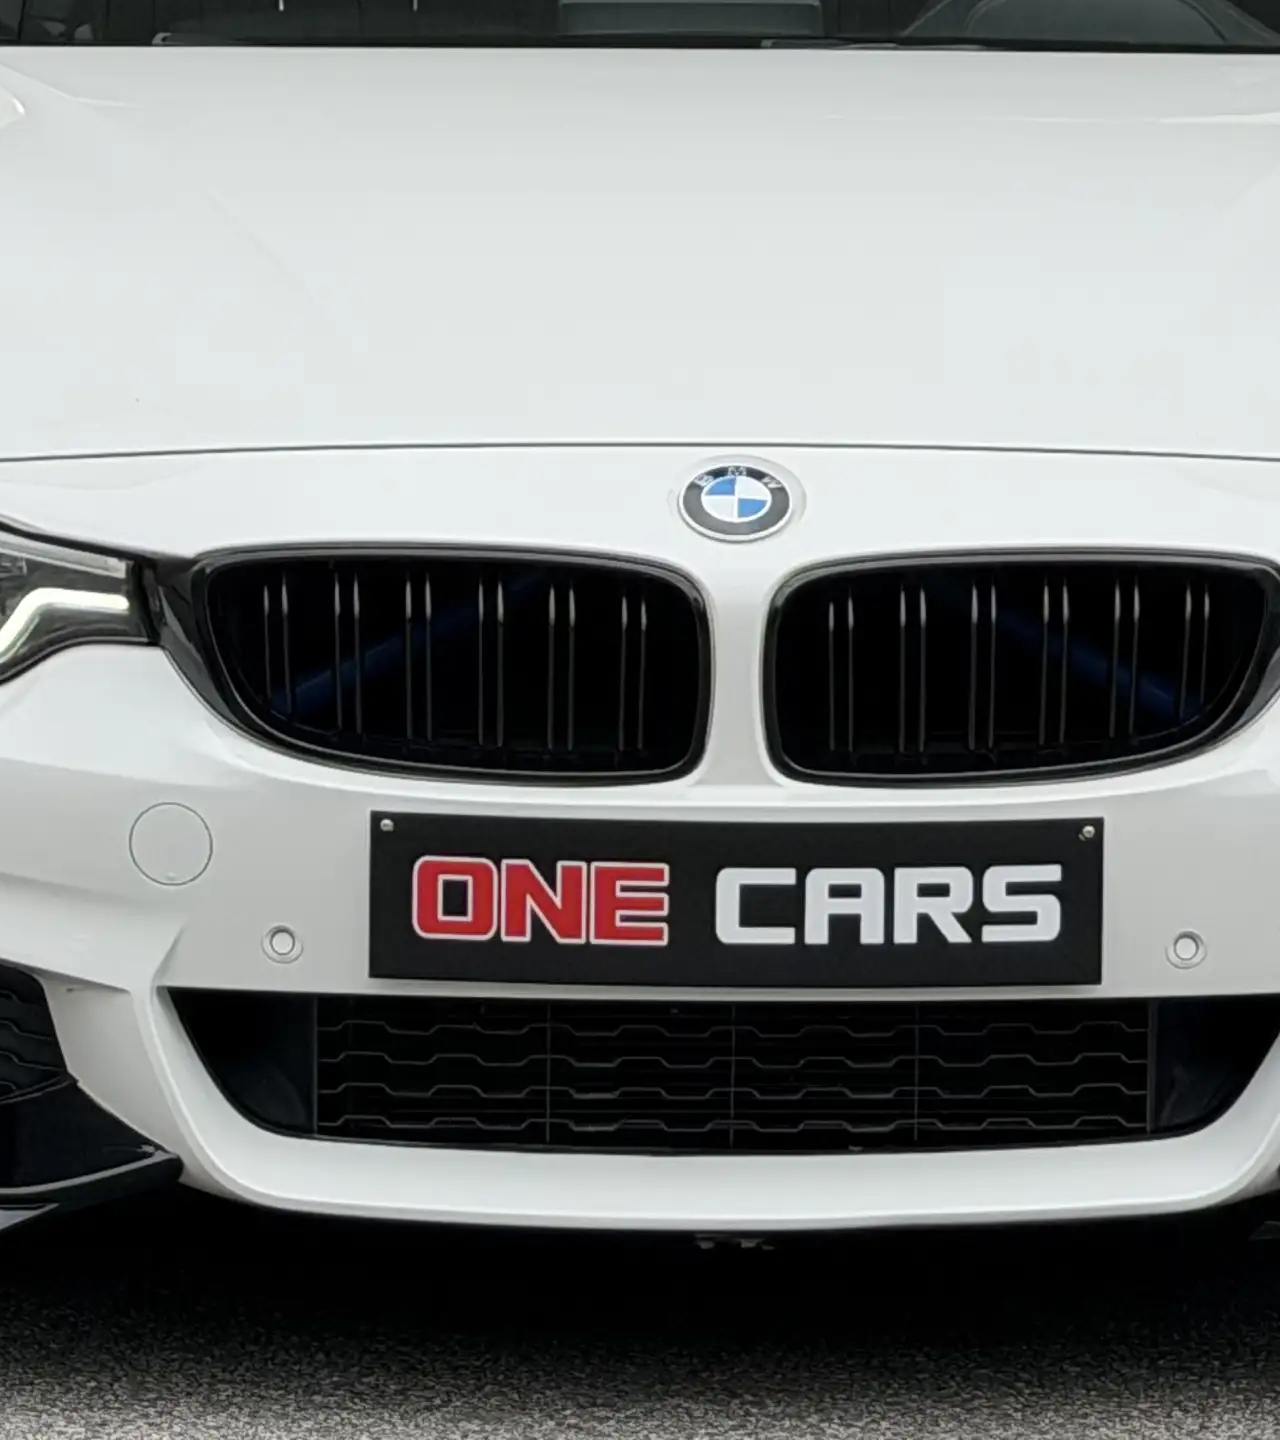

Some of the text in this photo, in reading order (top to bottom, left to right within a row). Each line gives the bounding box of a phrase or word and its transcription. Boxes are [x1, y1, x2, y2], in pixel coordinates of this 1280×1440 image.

[694, 465, 783, 489] BMW
[412, 855, 1062, 946] ONE CARS
